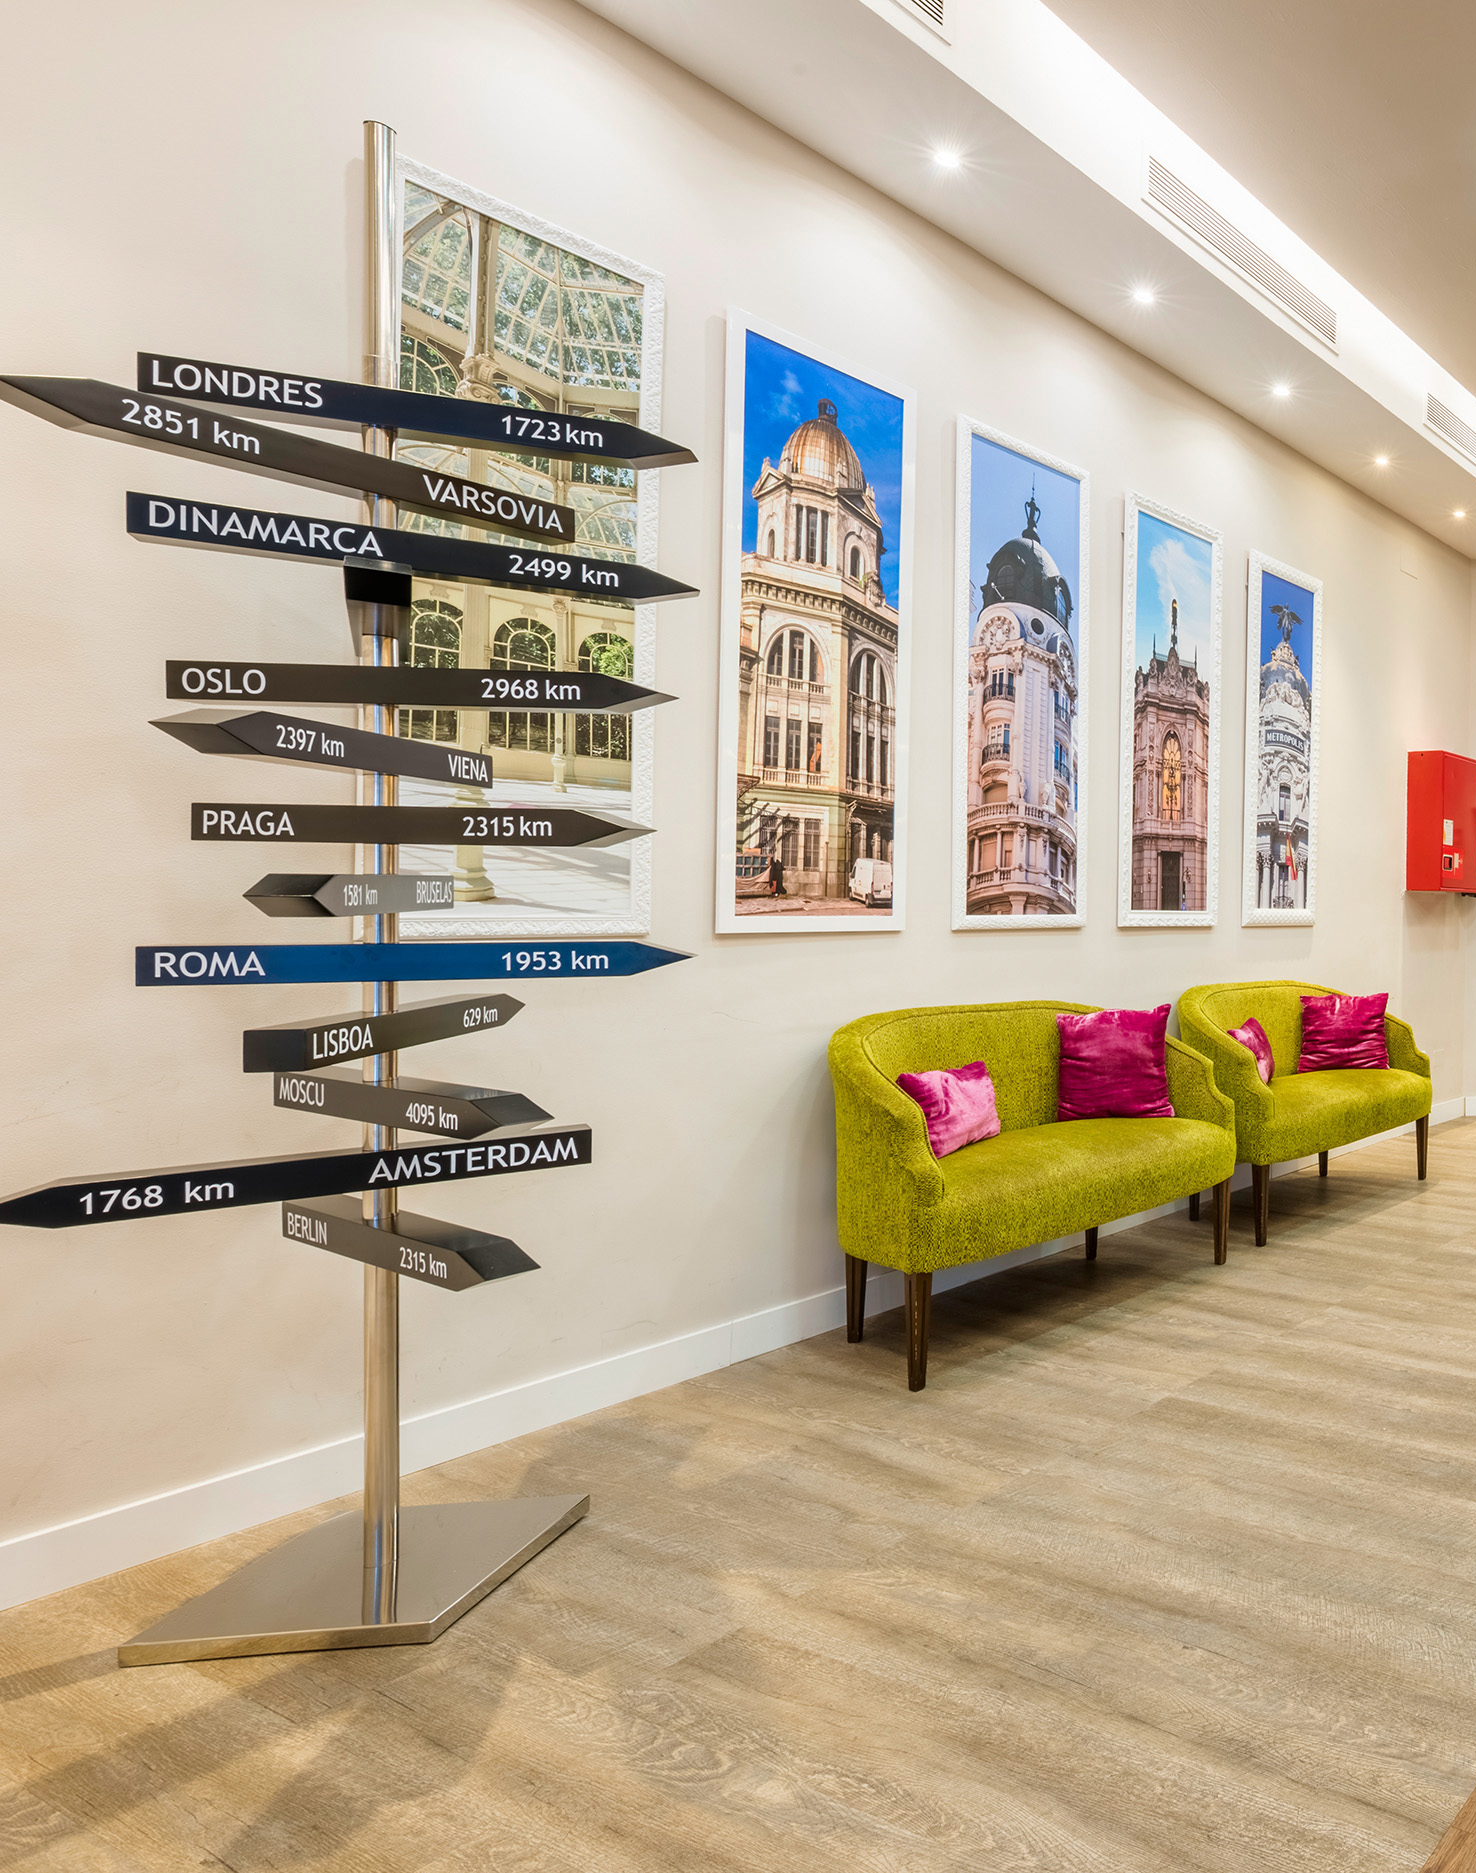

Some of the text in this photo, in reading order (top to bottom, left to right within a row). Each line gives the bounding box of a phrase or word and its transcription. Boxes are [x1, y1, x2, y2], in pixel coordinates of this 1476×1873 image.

[151, 359, 324, 409] LONDRES
[121, 398, 261, 455] 2851 km
[500, 414, 604, 448] 1723 km
[421, 474, 564, 533] VARSOVIA
[148, 501, 384, 558] DINAMARCA
[508, 554, 620, 588] 2499 km
[181, 667, 267, 695] OSLO
[480, 678, 581, 700] 2968 km
[275, 724, 345, 758] 2397 km
[1266, 732, 1304, 750] METROPOLIS
[448, 753, 489, 783] VIENA
[202, 810, 294, 837] PRAGA
[462, 816, 553, 837] 2315 km
[343, 884, 378, 907] 1581 km
[416, 879, 453, 904] BRUSELAS
[153, 951, 266, 978] ROMA
[501, 950, 609, 972] 1953 km
[463, 1007, 498, 1028] 629 km
[312, 1024, 374, 1061] LISBOA
[278, 1077, 325, 1108] MOSCU
[405, 1102, 458, 1131] 4095 km
[368, 1138, 579, 1183] AMSTERDAM
[79, 1180, 235, 1215] 1768 km
[287, 1212, 328, 1246] BERLIN
[400, 1247, 447, 1280] 2315 km
